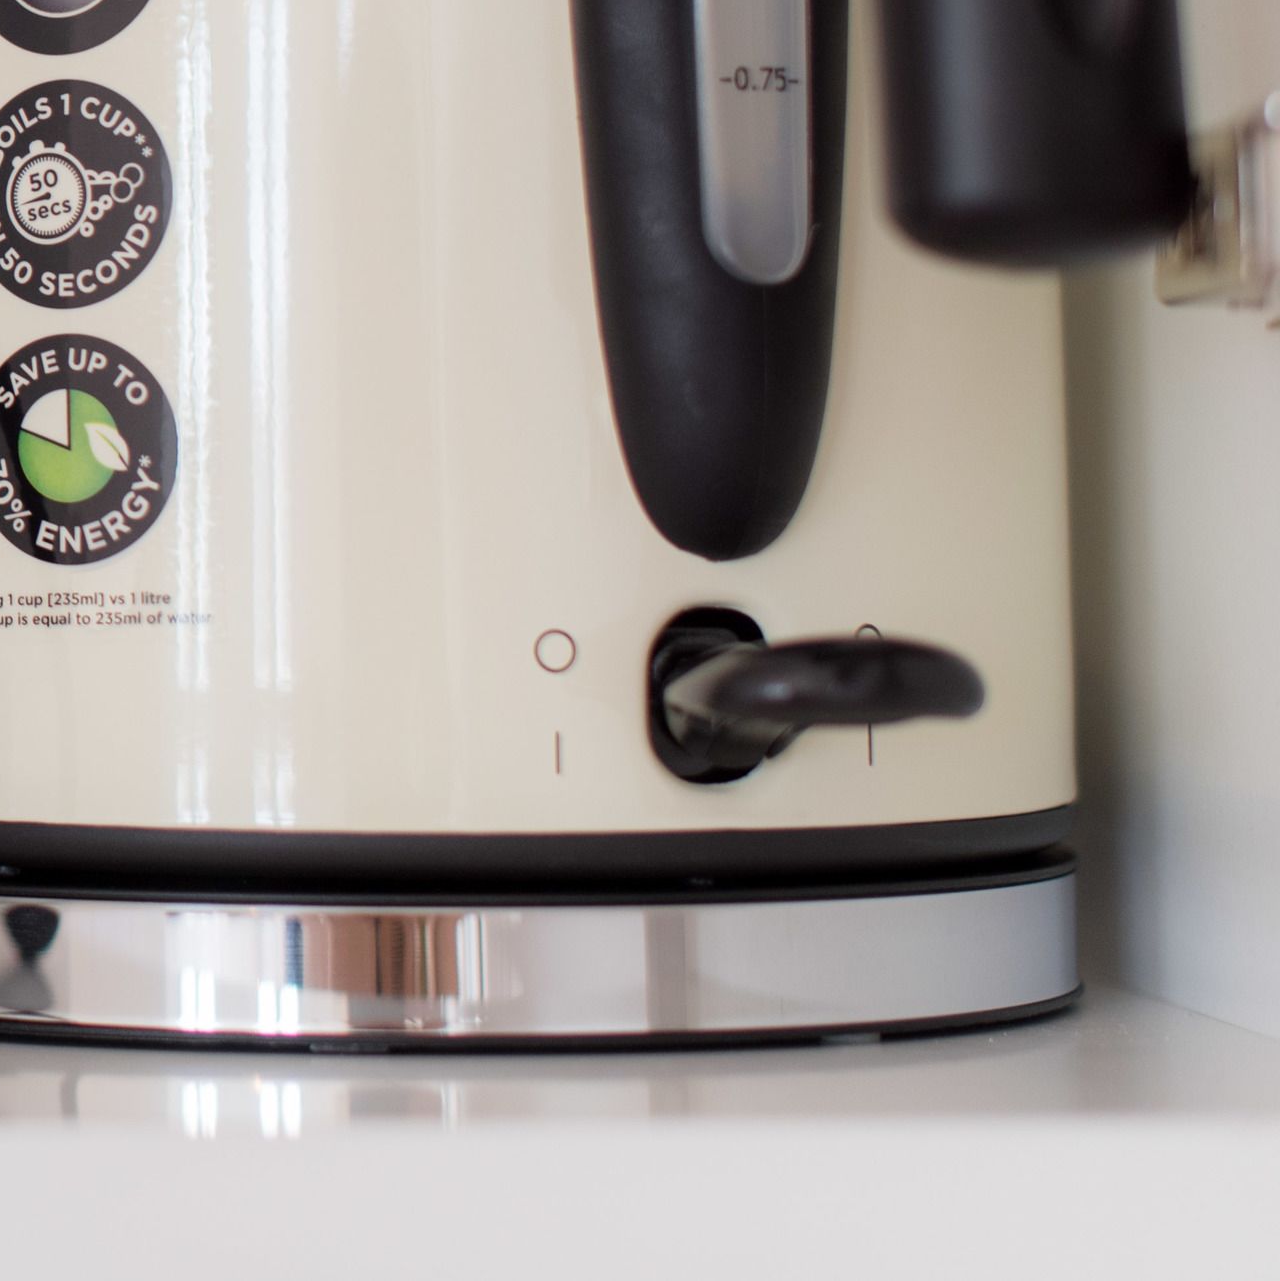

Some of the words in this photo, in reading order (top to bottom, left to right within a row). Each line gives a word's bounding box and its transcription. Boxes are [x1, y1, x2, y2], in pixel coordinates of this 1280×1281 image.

[734, 66, 787, 92] 0.75
[60, 93, 71, 116] 1
[29, 169, 58, 192] 50
[27, 197, 72, 222] secs
[38, 204, 159, 298] SECONDS
[67, 347, 108, 374] UP
[112, 364, 150, 406] TO
[8, 593, 14, 606] 1
[17, 595, 43, 608] cup
[109, 594, 125, 605] vs
[130, 592, 136, 605] 1
[140, 591, 171, 605] litre
[17, 612, 28, 625] is
[32, 612, 71, 627] equal
[76, 613, 91, 625] to
[96, 611, 141, 625] 235ml
[146, 611, 163, 625] of
